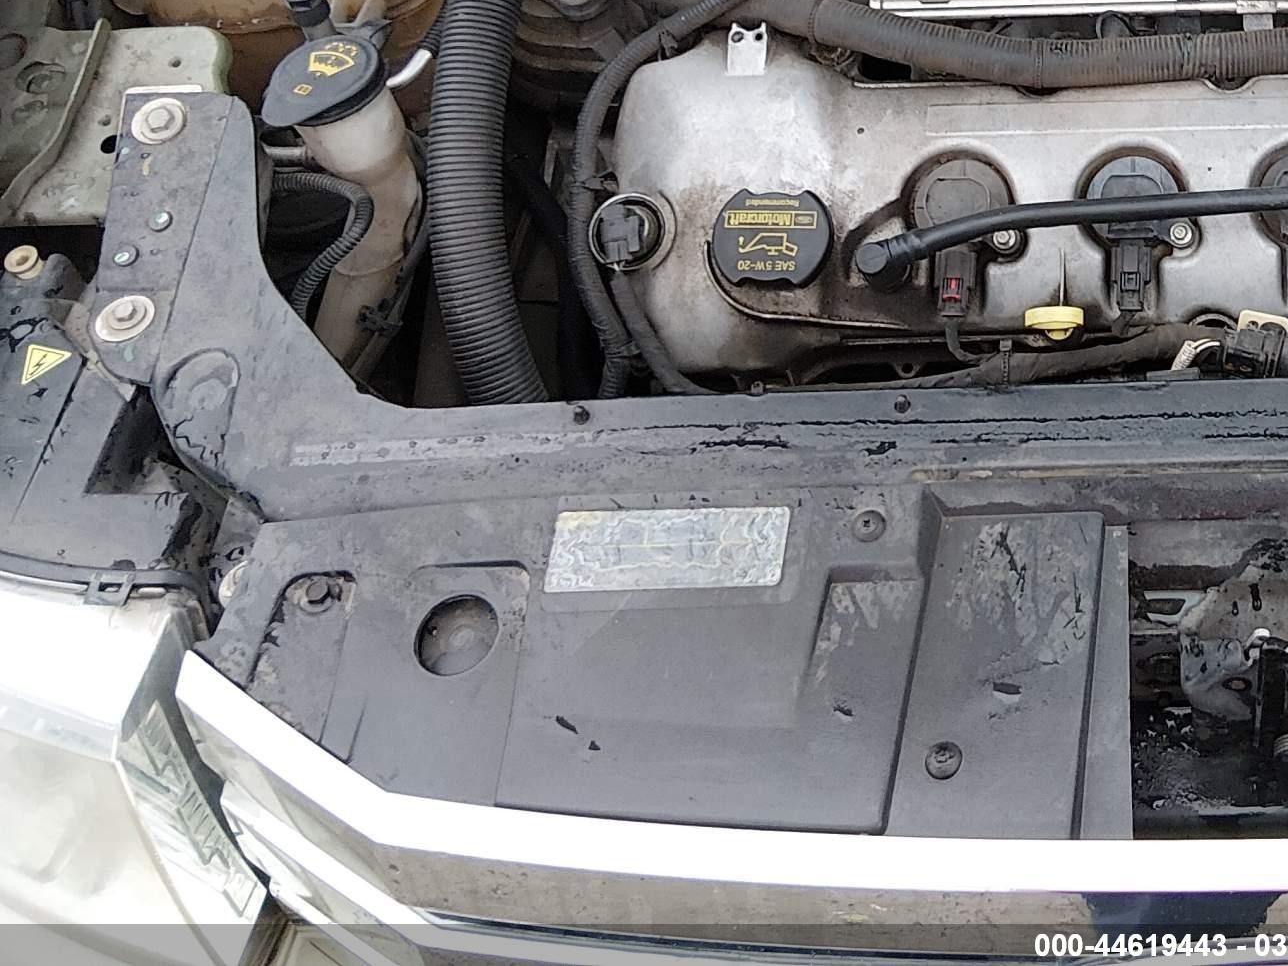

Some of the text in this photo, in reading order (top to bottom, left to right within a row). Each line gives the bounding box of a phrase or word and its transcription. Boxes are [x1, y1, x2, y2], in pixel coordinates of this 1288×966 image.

[728, 212, 791, 226] Motorcraft
[737, 260, 796, 271] SAE 5W-20
